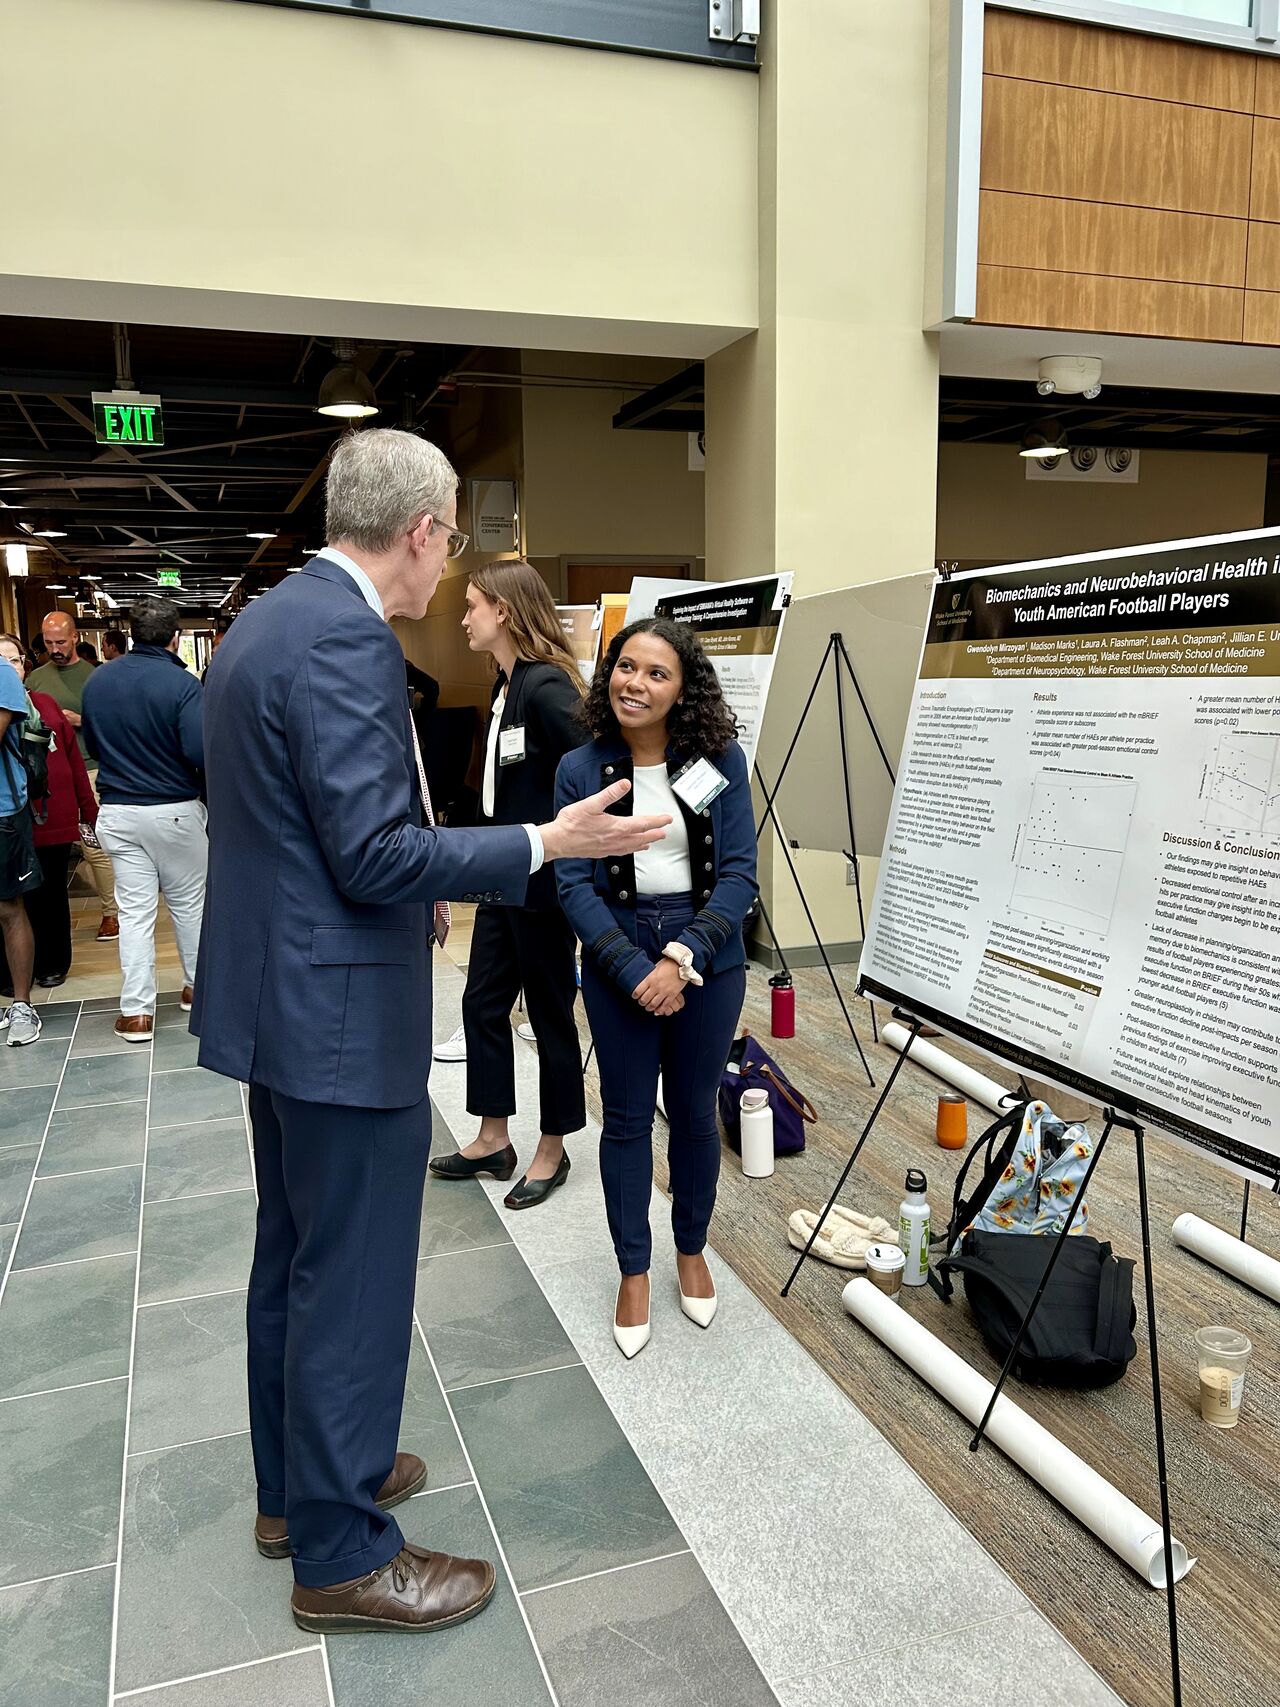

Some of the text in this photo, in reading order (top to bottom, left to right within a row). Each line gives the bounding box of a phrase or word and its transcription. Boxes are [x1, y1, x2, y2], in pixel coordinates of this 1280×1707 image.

[104, 406, 155, 441] EXIT
[986, 582, 1061, 603] Biomechanics
[1064, 581, 1086, 595] and
[1090, 564, 1208, 592] Neurobehavioral
[1212, 556, 1267, 580] Health
[1014, 592, 1229, 622] Youth American Football Players
[967, 644, 998, 653] Gwendolyn
[1030, 641, 1055, 650] Madison
[1081, 639, 1099, 648] Laura
[1101, 638, 1109, 647] A.
[1152, 635, 1170, 645] Leah
[1172, 635, 1181, 644] A.
[1230, 631, 1255, 642] Jillian
[1257, 630, 1267, 641] E.
[1020, 654, 1026, 662] of
[1026, 653, 1059, 662] Biomedical
[1059, 652, 1098, 663] Engineering,
[1100, 651, 1120, 660] Wake
[1121, 650, 1144, 660] Forest
[1146, 649, 1183, 660] University
[1185, 648, 1213, 658] School
[1215, 647, 1224, 658] of
[1226, 646, 1265, 657] Medicine
[1027, 666, 1033, 674] of
[1034, 666, 1086, 676] Neuropsychology,
[1088, 665, 1107, 674] Wake
[1108, 664, 1130, 674] Forest
[1132, 664, 1169, 675] University
[1170, 663, 1198, 673] School
[1199, 662, 1208, 673] of
[1210, 662, 1248, 673] Medicine
[920, 691, 946, 699] Introduction
[1034, 692, 1057, 701] Results
[1163, 832, 1211, 848] Discussion
[1214, 840, 1220, 850] &
[1164, 863, 1185, 872] athletes
[1187, 868, 1211, 877] exposed
[1219, 874, 1247, 884] repetitive
[1248, 878, 1266, 888] HAEs
[1178, 853, 1199, 865] findings
[1201, 859, 1212, 868] may
[1228, 864, 1248, 873] insight
[1138, 976, 1160, 987] younger
[1161, 983, 1175, 992] adult
[1176, 986, 1195, 998] football
[1196, 994, 1218, 1006] players
[1127, 1013, 1160, 1030] Post-season
[1161, 1027, 1184, 1039] increase
[1192, 1038, 1220, 1052] executive
[1221, 1046, 1246, 1062] function
[1248, 1057, 1277, 1073] supports
[1116, 1047, 1261, 1110] Future work should explore relationships between
[1113, 1059, 1156, 1080] neurobehavioral
[1157, 1075, 1174, 1088] health
[1176, 1084, 1187, 1093] and
[1189, 1088, 1204, 1100] head
[1206, 1095, 1240, 1114] kinematics
[1251, 1114, 1271, 1126] youth
